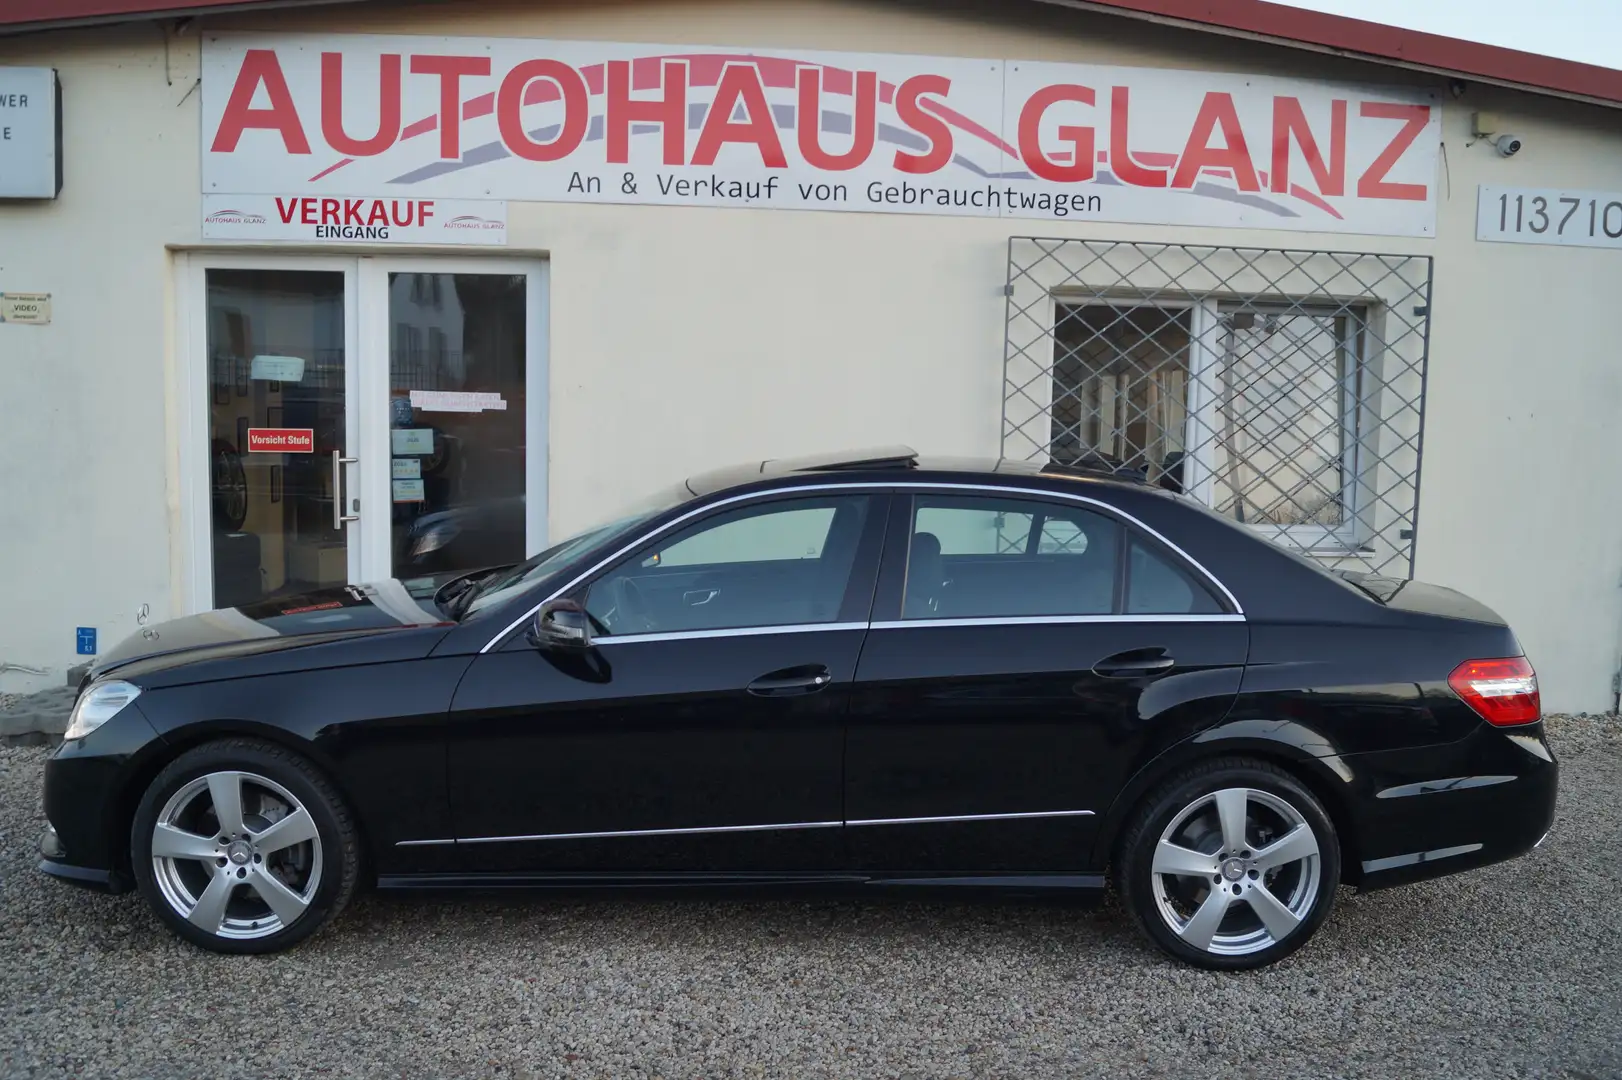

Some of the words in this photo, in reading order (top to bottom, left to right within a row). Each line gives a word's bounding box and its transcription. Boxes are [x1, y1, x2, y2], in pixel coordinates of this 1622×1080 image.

[211, 49, 954, 174] AUTOHAUS
[1017, 83, 1430, 201] GLANZ
[567, 171, 601, 193] An
[621, 171, 638, 194] &
[656, 174, 779, 199] Verkauf
[798, 182, 848, 201] von
[866, 181, 1102, 216] Gebrauchtwagen
[274, 196, 435, 228] VERKAUF
[1499, 193, 1622, 238] 113710
[315, 225, 389, 240] EINGANG
[443, 222, 480, 230] AUTOHAUS
[13, 304, 38, 312] VIDEO
[251, 435, 286, 445] Vorsicht
[287, 435, 310, 445] Stufe
